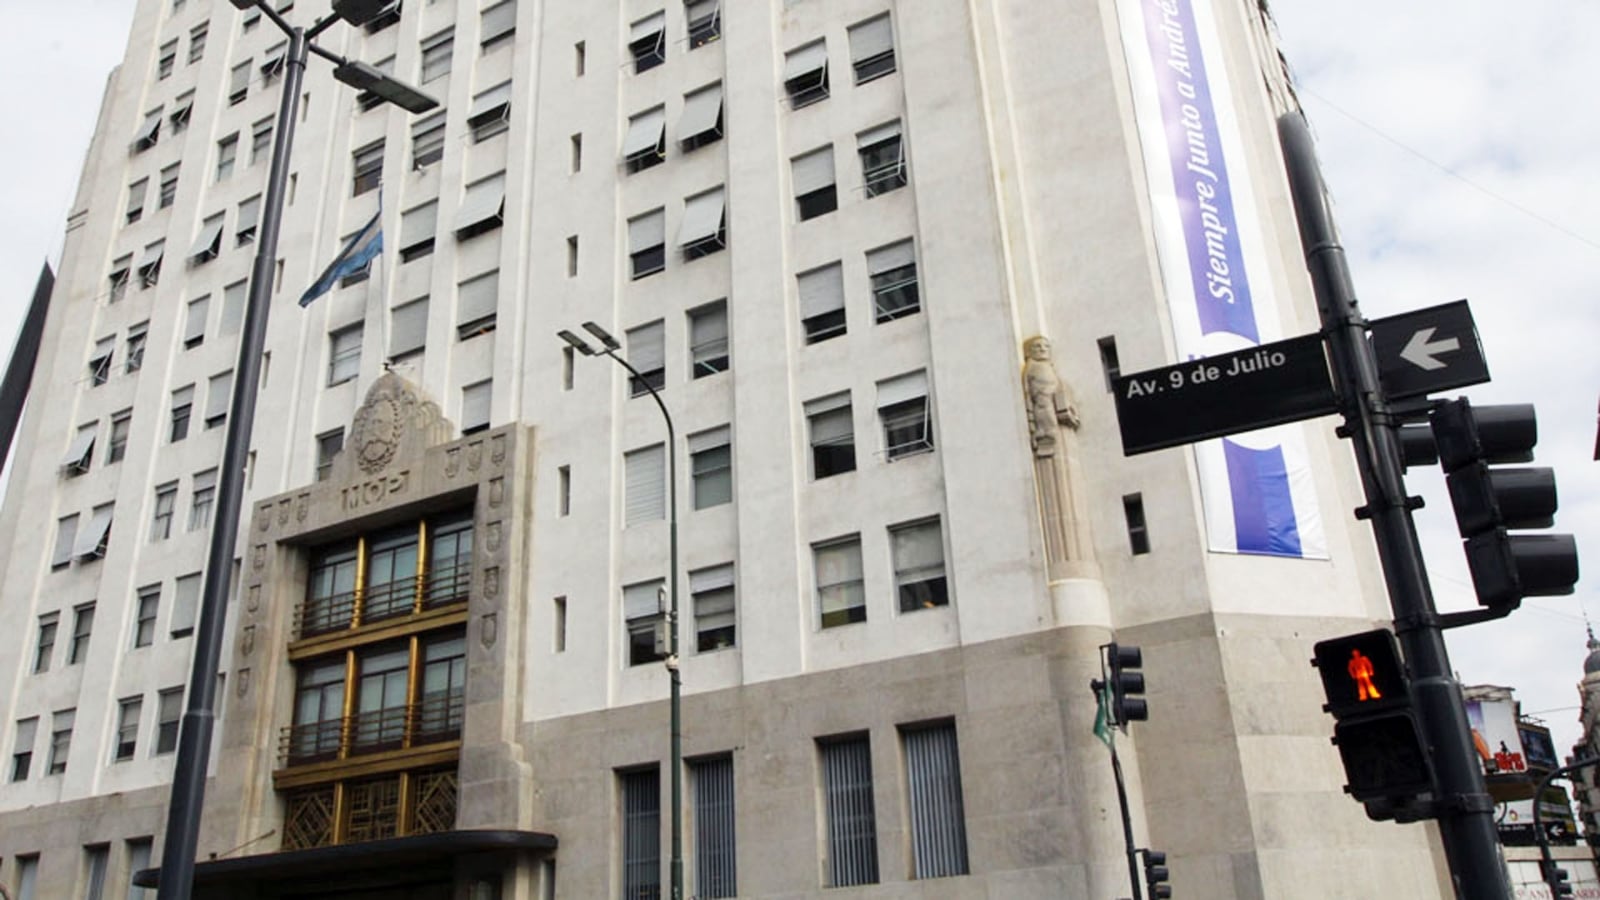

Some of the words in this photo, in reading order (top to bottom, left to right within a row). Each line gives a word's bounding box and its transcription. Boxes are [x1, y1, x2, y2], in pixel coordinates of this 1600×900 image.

[1176, 82, 1196, 99] a
[1186, 105, 1219, 183] Junto
[1200, 178, 1235, 304] Siempre
[1126, 379, 1164, 399] Av.
[1169, 370, 1185, 389] 9
[1191, 364, 1221, 384] de
[1226, 350, 1286, 377] Julio
